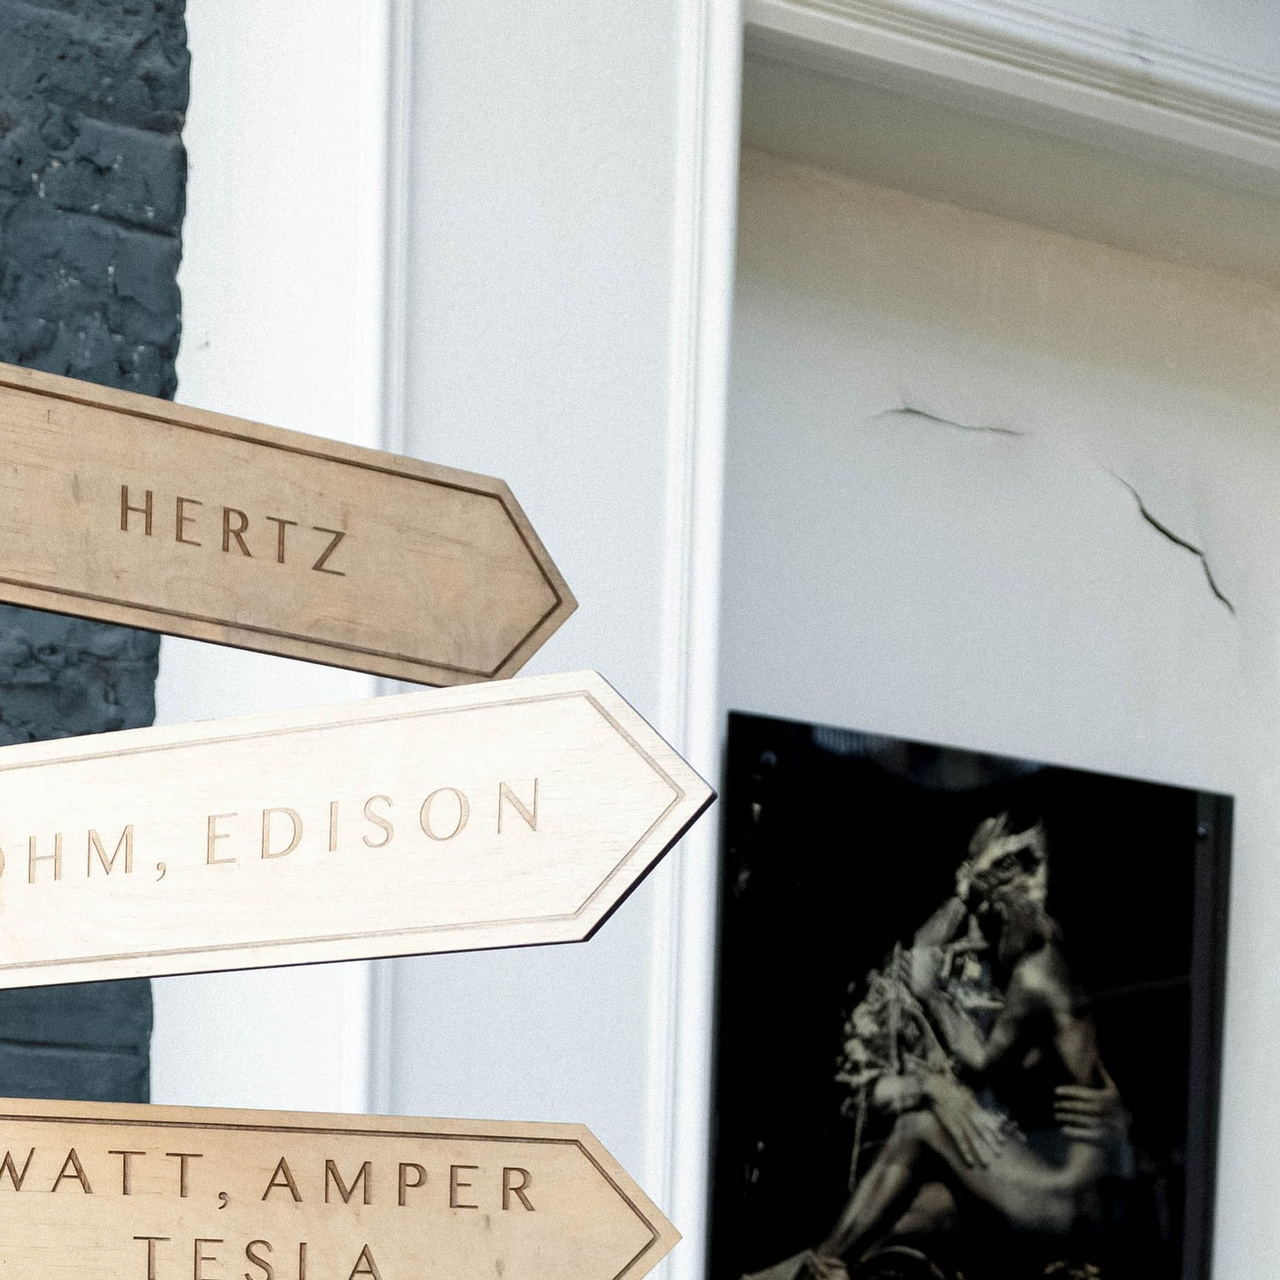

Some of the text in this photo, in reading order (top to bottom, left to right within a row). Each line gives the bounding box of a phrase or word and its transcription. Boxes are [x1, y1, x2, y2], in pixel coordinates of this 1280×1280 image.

[119, 484, 347, 577] HERTZ
[205, 777, 542, 866] EDISON
[261, 1156, 537, 1212] AMPER
